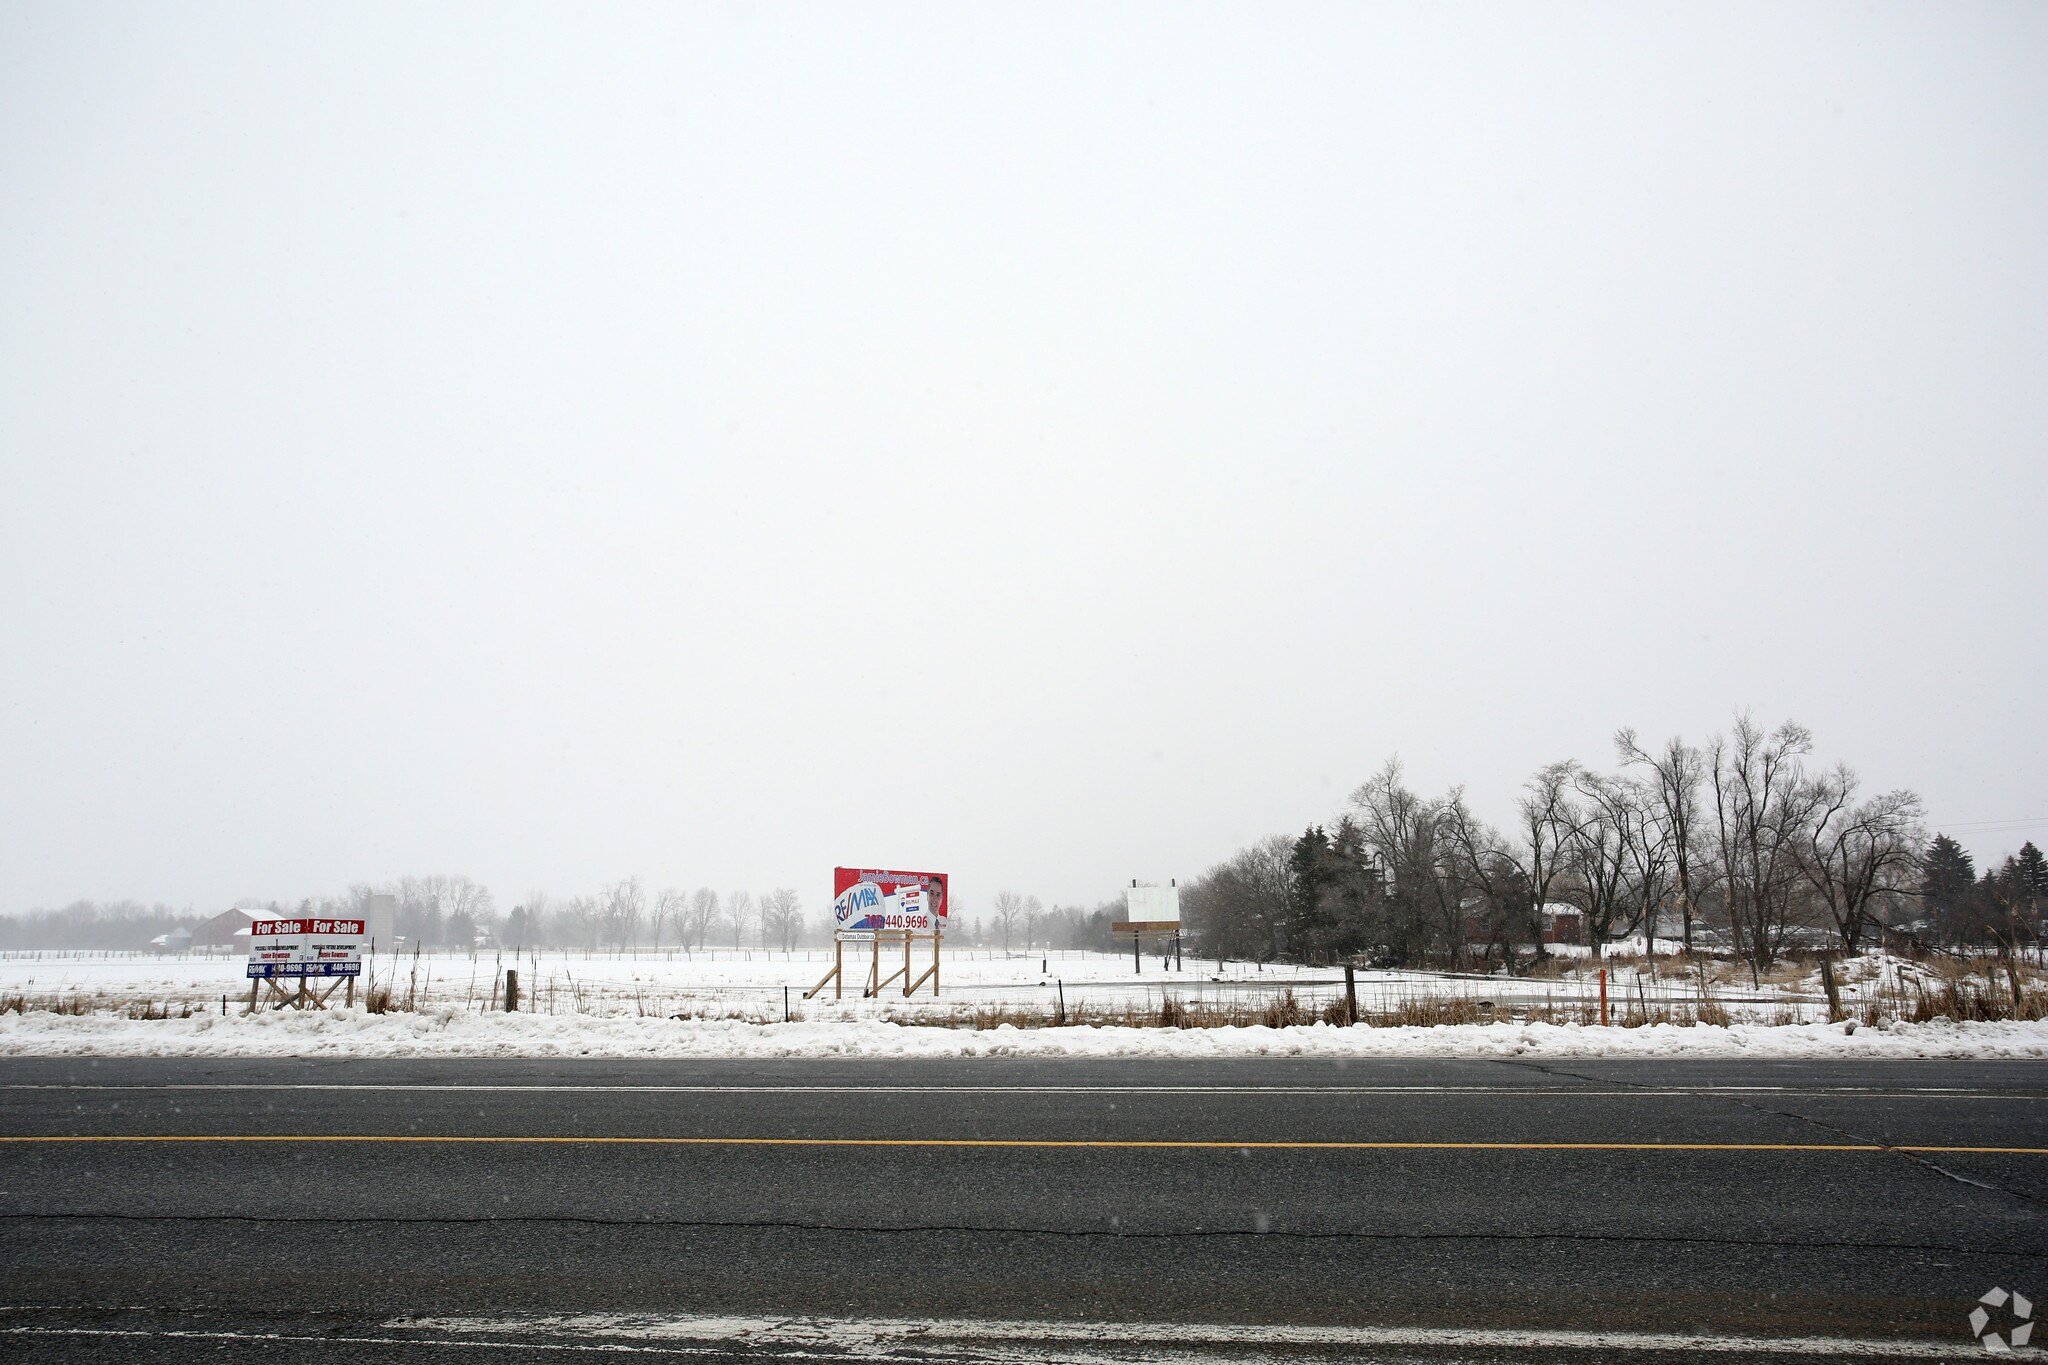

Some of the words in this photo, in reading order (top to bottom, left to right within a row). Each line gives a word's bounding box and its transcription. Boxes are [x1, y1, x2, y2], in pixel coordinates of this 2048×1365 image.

[858, 870, 929, 885] JamieBowman.ca
[834, 887, 879, 925] RE/MAX
[256, 922, 273, 934] For
[275, 921, 301, 933] Sale
[313, 920, 332, 933] For
[334, 921, 358, 933] Sale
[865, 914, 928, 928] 705.440.9696
